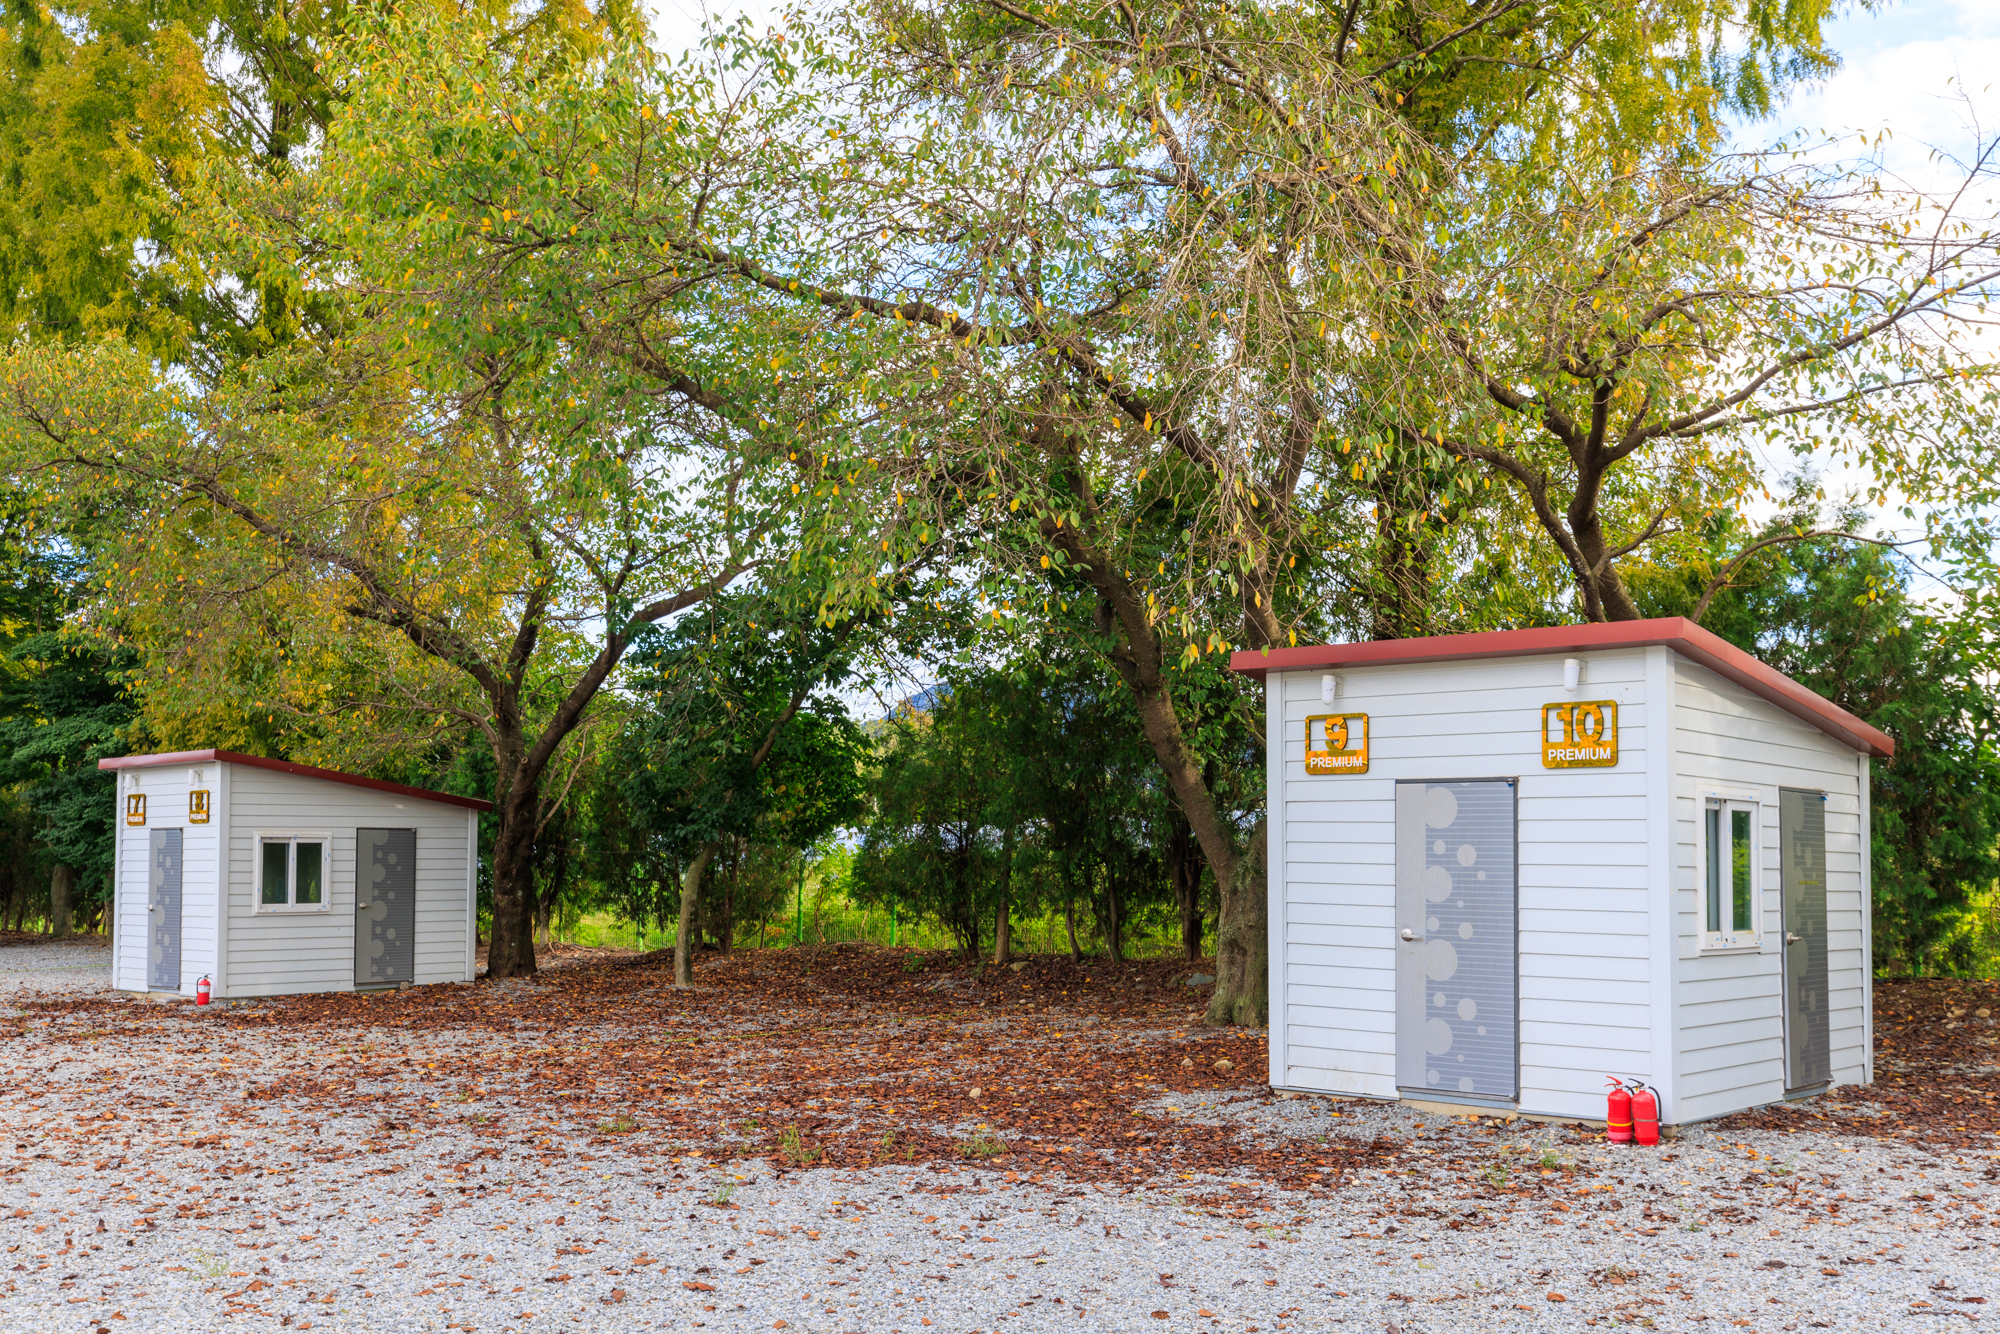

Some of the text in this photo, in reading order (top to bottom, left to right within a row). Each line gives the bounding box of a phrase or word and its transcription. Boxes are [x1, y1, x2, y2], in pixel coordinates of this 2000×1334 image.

[1325, 716, 1348, 752] 9
[1556, 704, 1604, 742] 10
[1310, 756, 1363, 768] PREMIUM
[1548, 747, 1611, 761] PREMIUM
